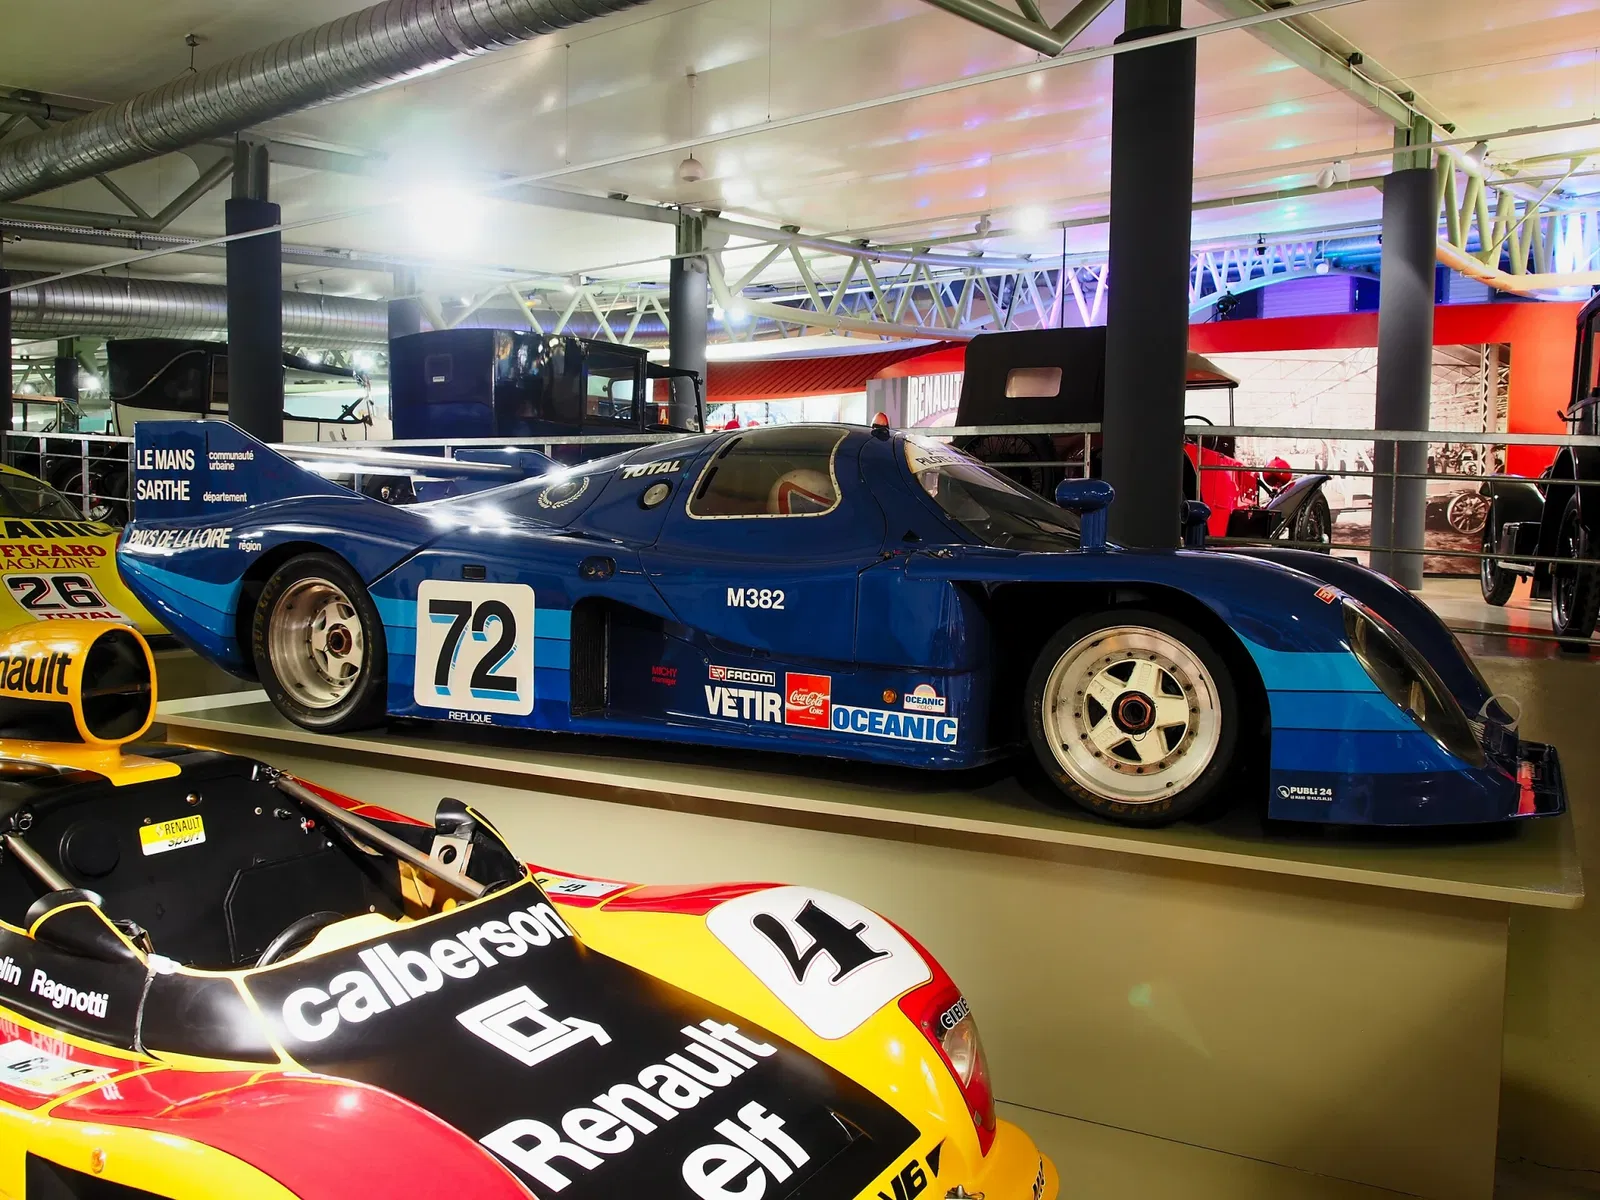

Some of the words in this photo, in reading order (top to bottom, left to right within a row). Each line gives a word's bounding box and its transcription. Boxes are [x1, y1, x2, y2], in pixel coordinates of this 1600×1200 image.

[137, 449, 153, 470] LE
[156, 449, 195, 471] MANS
[208, 450, 254, 461] communauté
[209, 461, 235, 471] urbaine
[622, 460, 680, 479] TOTAL
[136, 479, 191, 501] SARTHE
[203, 491, 248, 503] département
[0, 520, 113, 539] ANIC
[129, 529, 158, 545] PAYS
[156, 530, 178, 547] DE
[173, 529, 193, 547] LA
[191, 528, 233, 548] LOIRE
[0, 544, 107, 557] FIGARO
[238, 540, 262, 553] région
[8, 576, 105, 609] 26
[727, 588, 785, 609] M382
[429, 599, 519, 700] 72
[727, 670, 773, 684] FACOM
[704, 685, 782, 723] VETIR
[905, 695, 944, 706] OCEANIC
[448, 711, 492, 723] REPLIQUE
[833, 707, 956, 742] OCEANIC
[1319, 788, 1332, 796] 24
[164, 817, 200, 835] RENAULT
[752, 898, 891, 984] 4
[282, 902, 573, 1041] calberson
[0, 956, 22, 985] lin
[30, 968, 109, 1018] Ragnotti
[479, 1019, 777, 1193] Renault
[682, 1100, 811, 1200] elf
